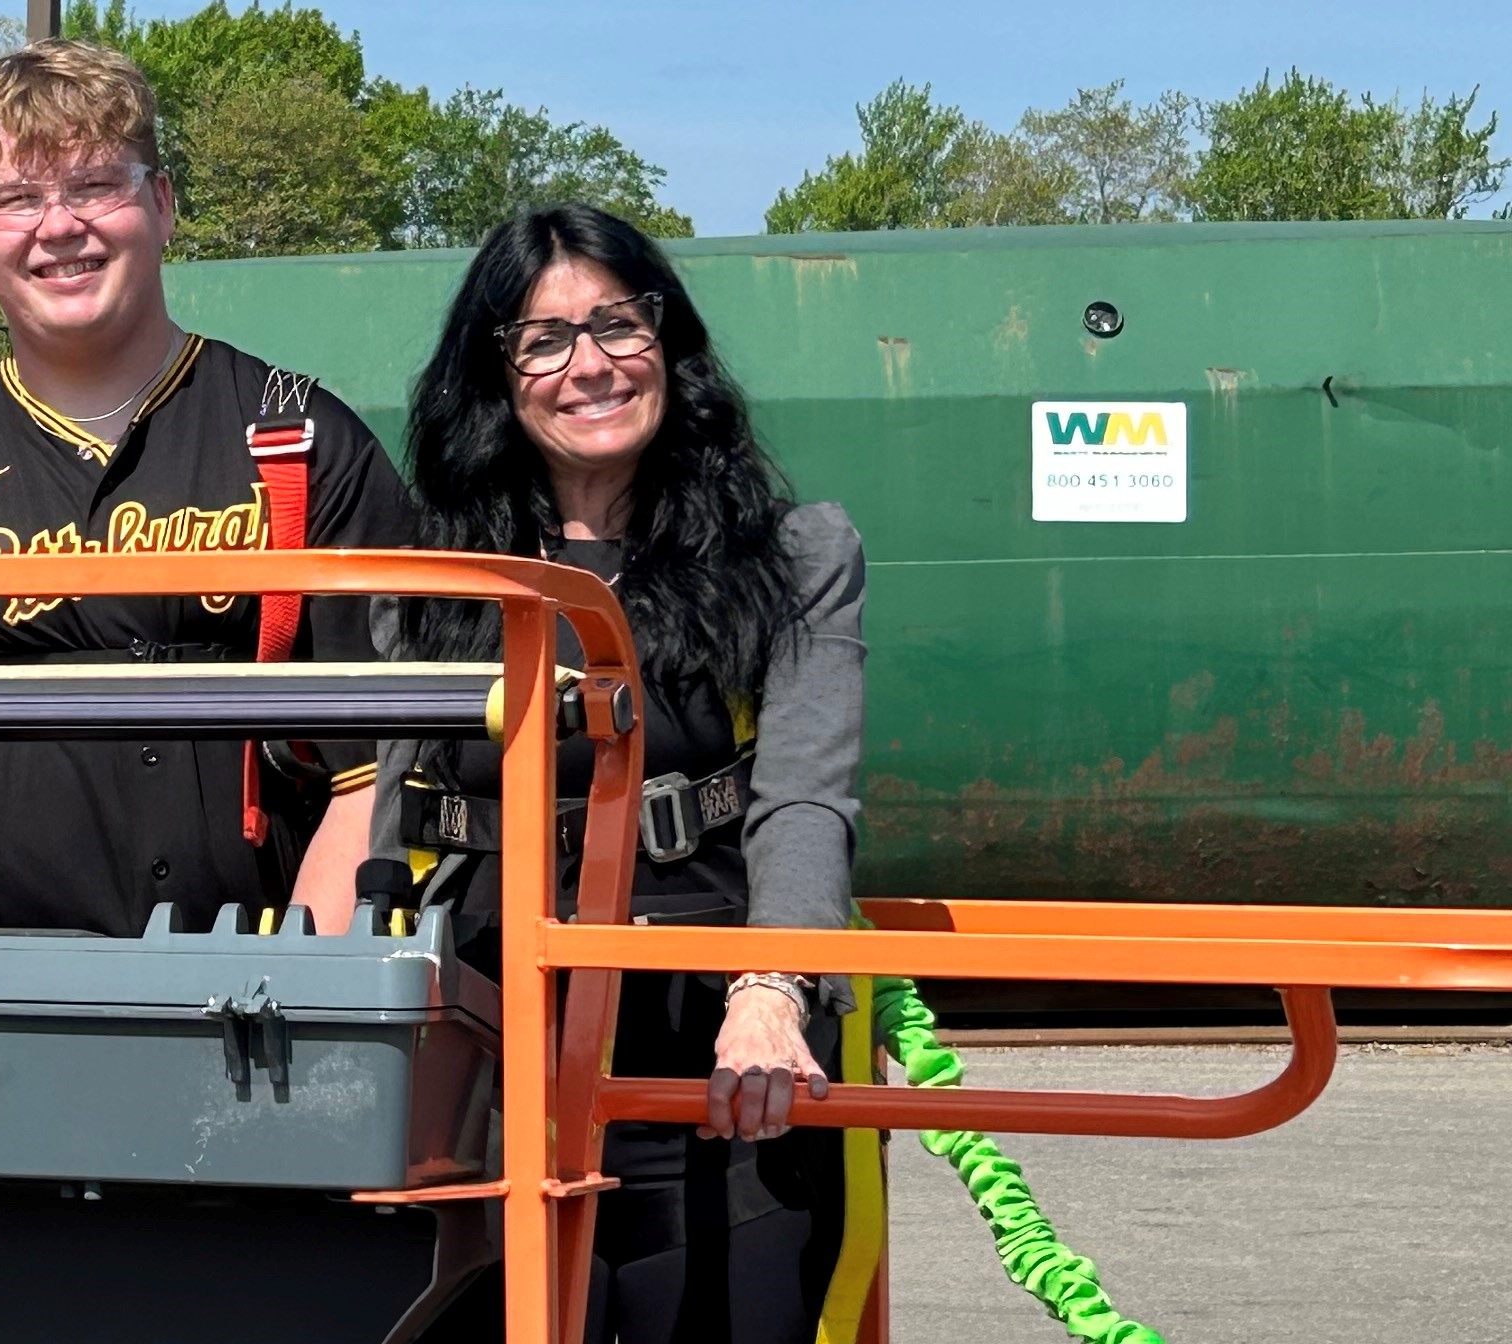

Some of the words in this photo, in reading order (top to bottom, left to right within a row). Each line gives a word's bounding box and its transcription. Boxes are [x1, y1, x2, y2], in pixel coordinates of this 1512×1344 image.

[1046, 412, 1168, 445] WM
[1047, 474, 1081, 488] 800
[1088, 474, 1119, 488] 451
[1129, 474, 1173, 488] 3060
